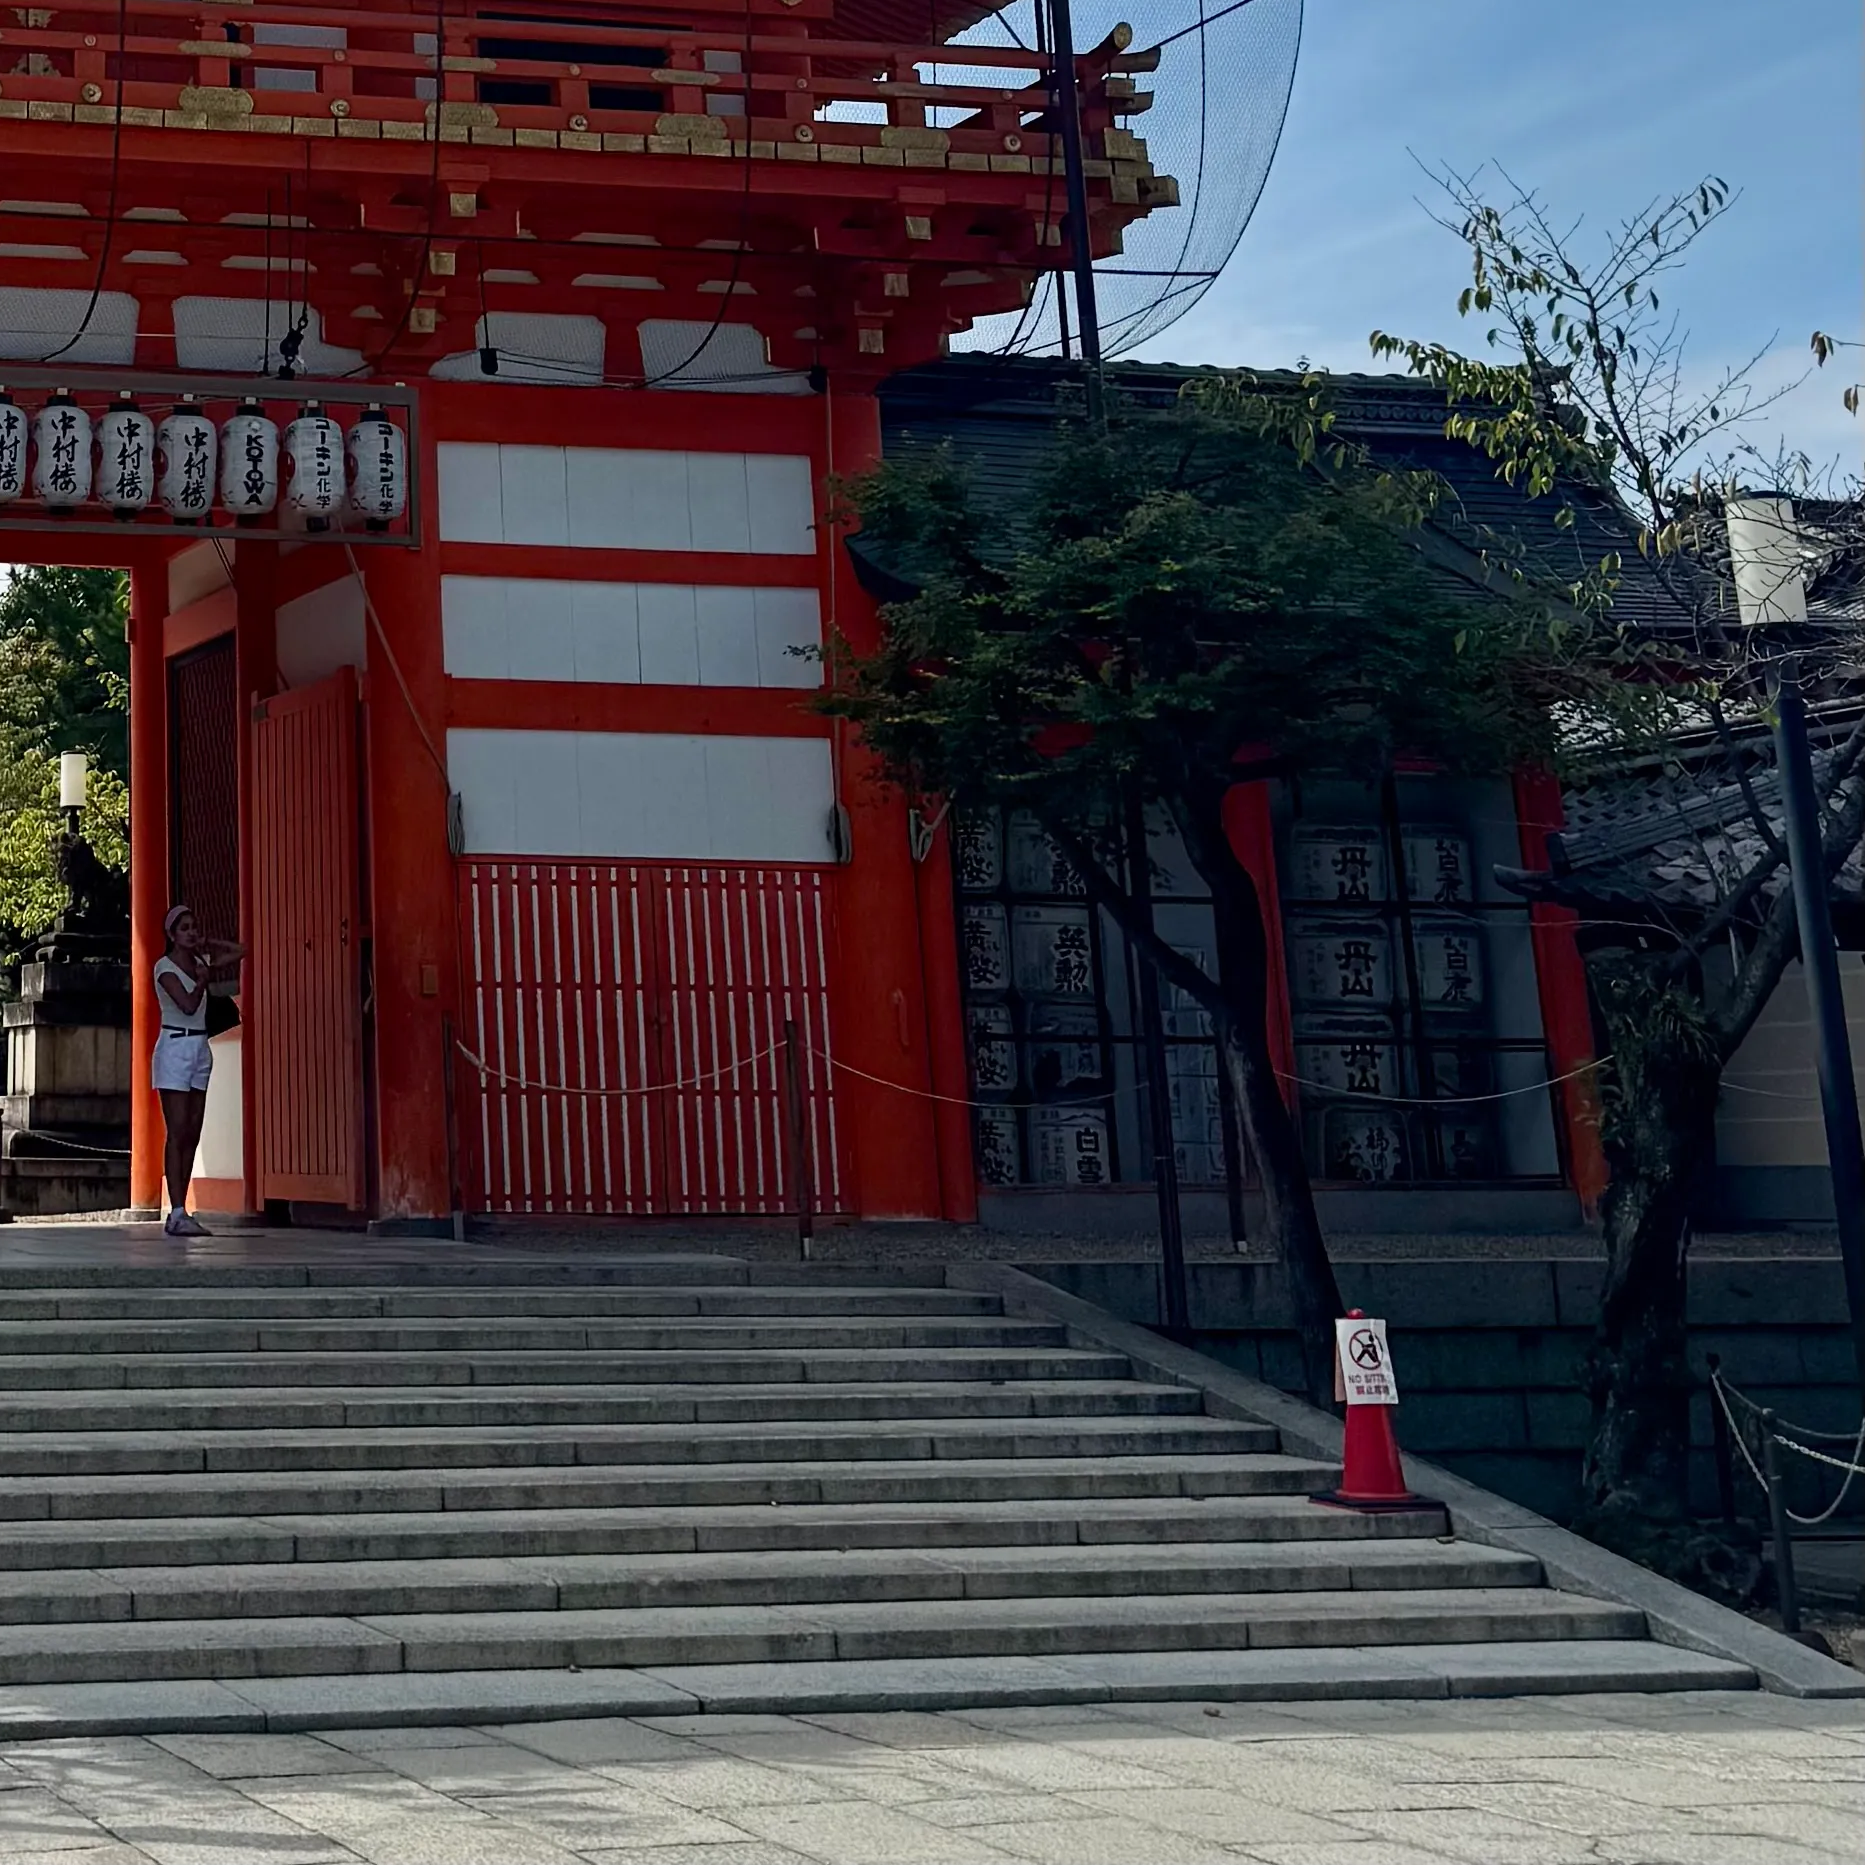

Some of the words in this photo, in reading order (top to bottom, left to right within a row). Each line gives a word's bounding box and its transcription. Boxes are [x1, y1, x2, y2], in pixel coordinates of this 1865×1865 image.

[243, 434, 266, 506] KOTOWA
[315, 418, 332, 509] コーキン化学
[377, 423, 394, 515] コーキン化学
[1075, 1127, 1104, 1184] 白雪
